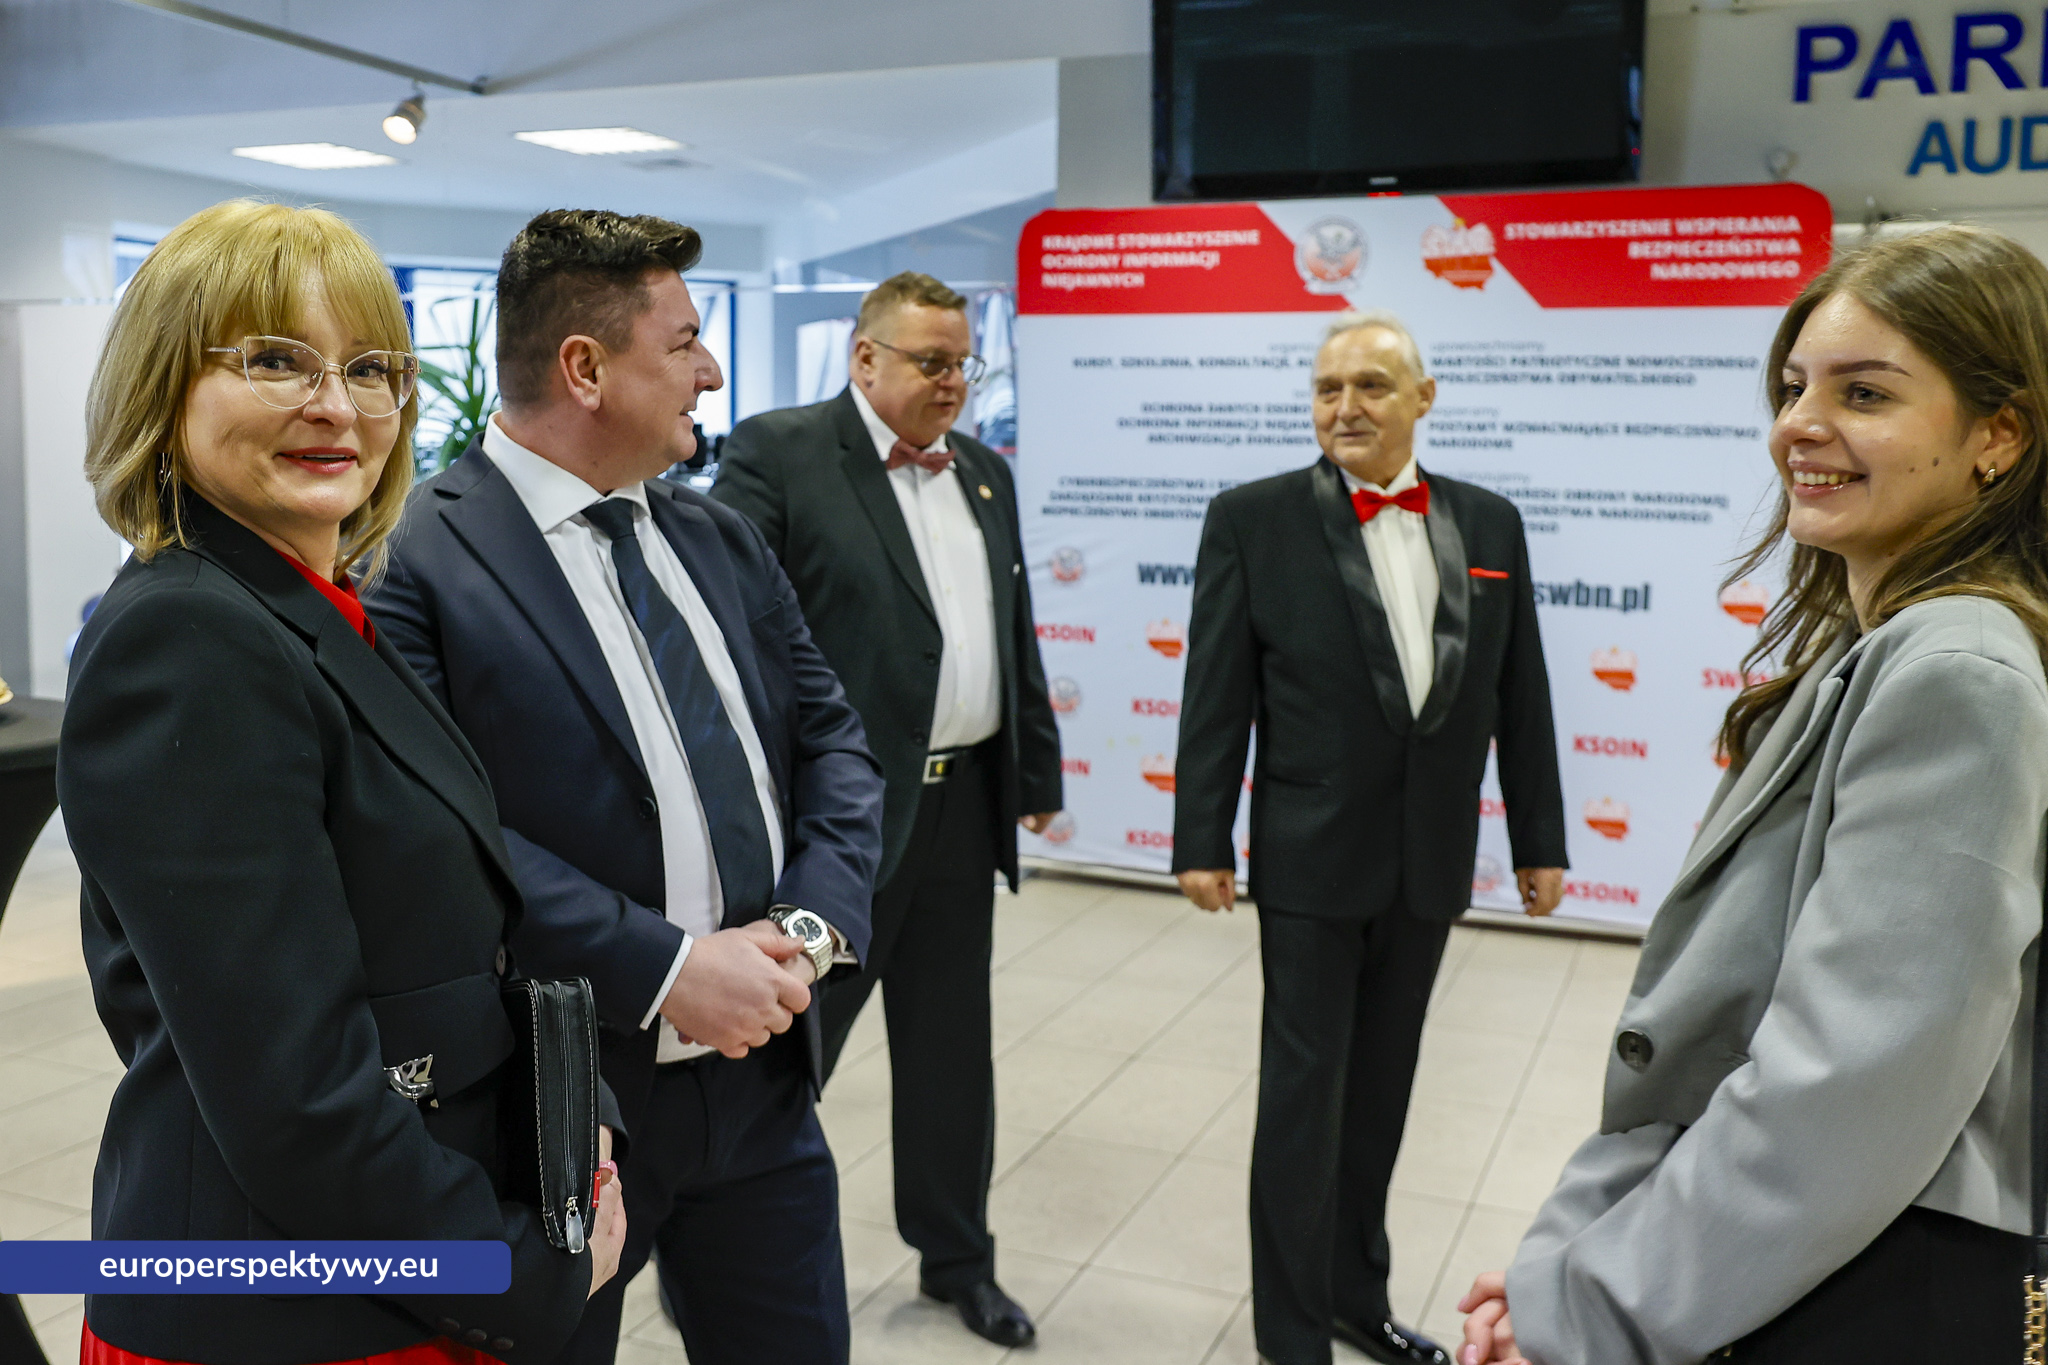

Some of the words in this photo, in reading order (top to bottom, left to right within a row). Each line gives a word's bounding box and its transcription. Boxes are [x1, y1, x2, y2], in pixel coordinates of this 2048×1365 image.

[1792, 9, 2048, 104] PAR
[1504, 218, 1671, 241] STOWARZYSZENIE
[1674, 215, 1802, 236] WSPIERANIA
[1041, 234, 1115, 253] KRAJOWE
[1117, 229, 1261, 249] STOWARZYSZENIE
[1627, 236, 1801, 260] BEZPIECZEŃSTWA
[1041, 252, 1121, 270] OCHRONY
[1122, 250, 1221, 270] INFORMACJI
[1650, 260, 1800, 281] NARODOWEGO
[1041, 271, 1145, 292] NIEJAWNYCH
[1132, 698, 1180, 718] KSOI
[1573, 734, 1649, 760] KSOIN
[1126, 829, 1174, 849] KSOI
[1564, 880, 1640, 906] KSOIN
